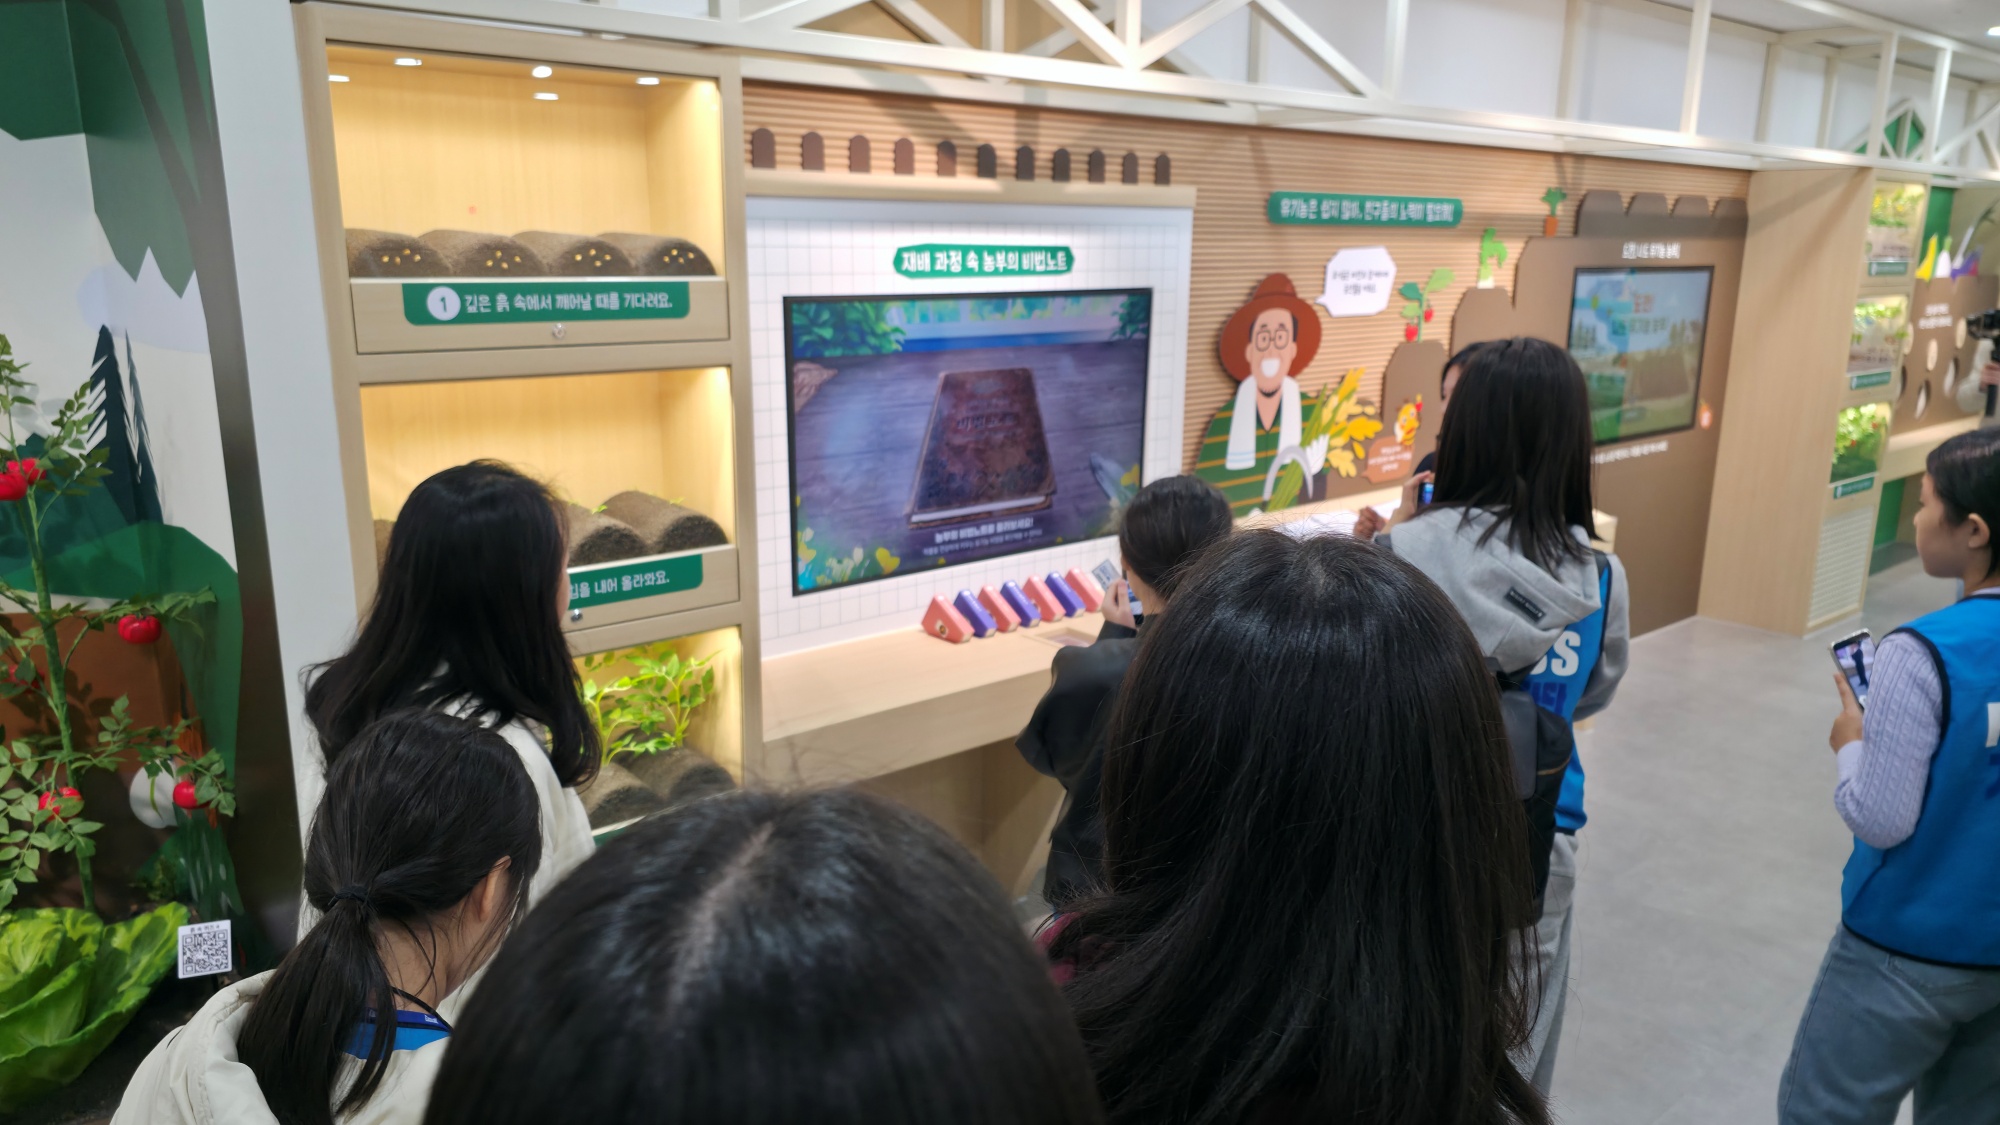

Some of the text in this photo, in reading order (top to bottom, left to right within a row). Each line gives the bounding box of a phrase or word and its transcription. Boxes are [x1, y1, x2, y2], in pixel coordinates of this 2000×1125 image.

[902, 250, 1067, 273] 재배 과정 속 농부의 비법노트
[464, 291, 673, 313] 깊은 흙 속에서 깨어날 때를 기다려요.
[594, 577, 618, 594] 내어
[622, 570, 670, 592] 올라와요.
